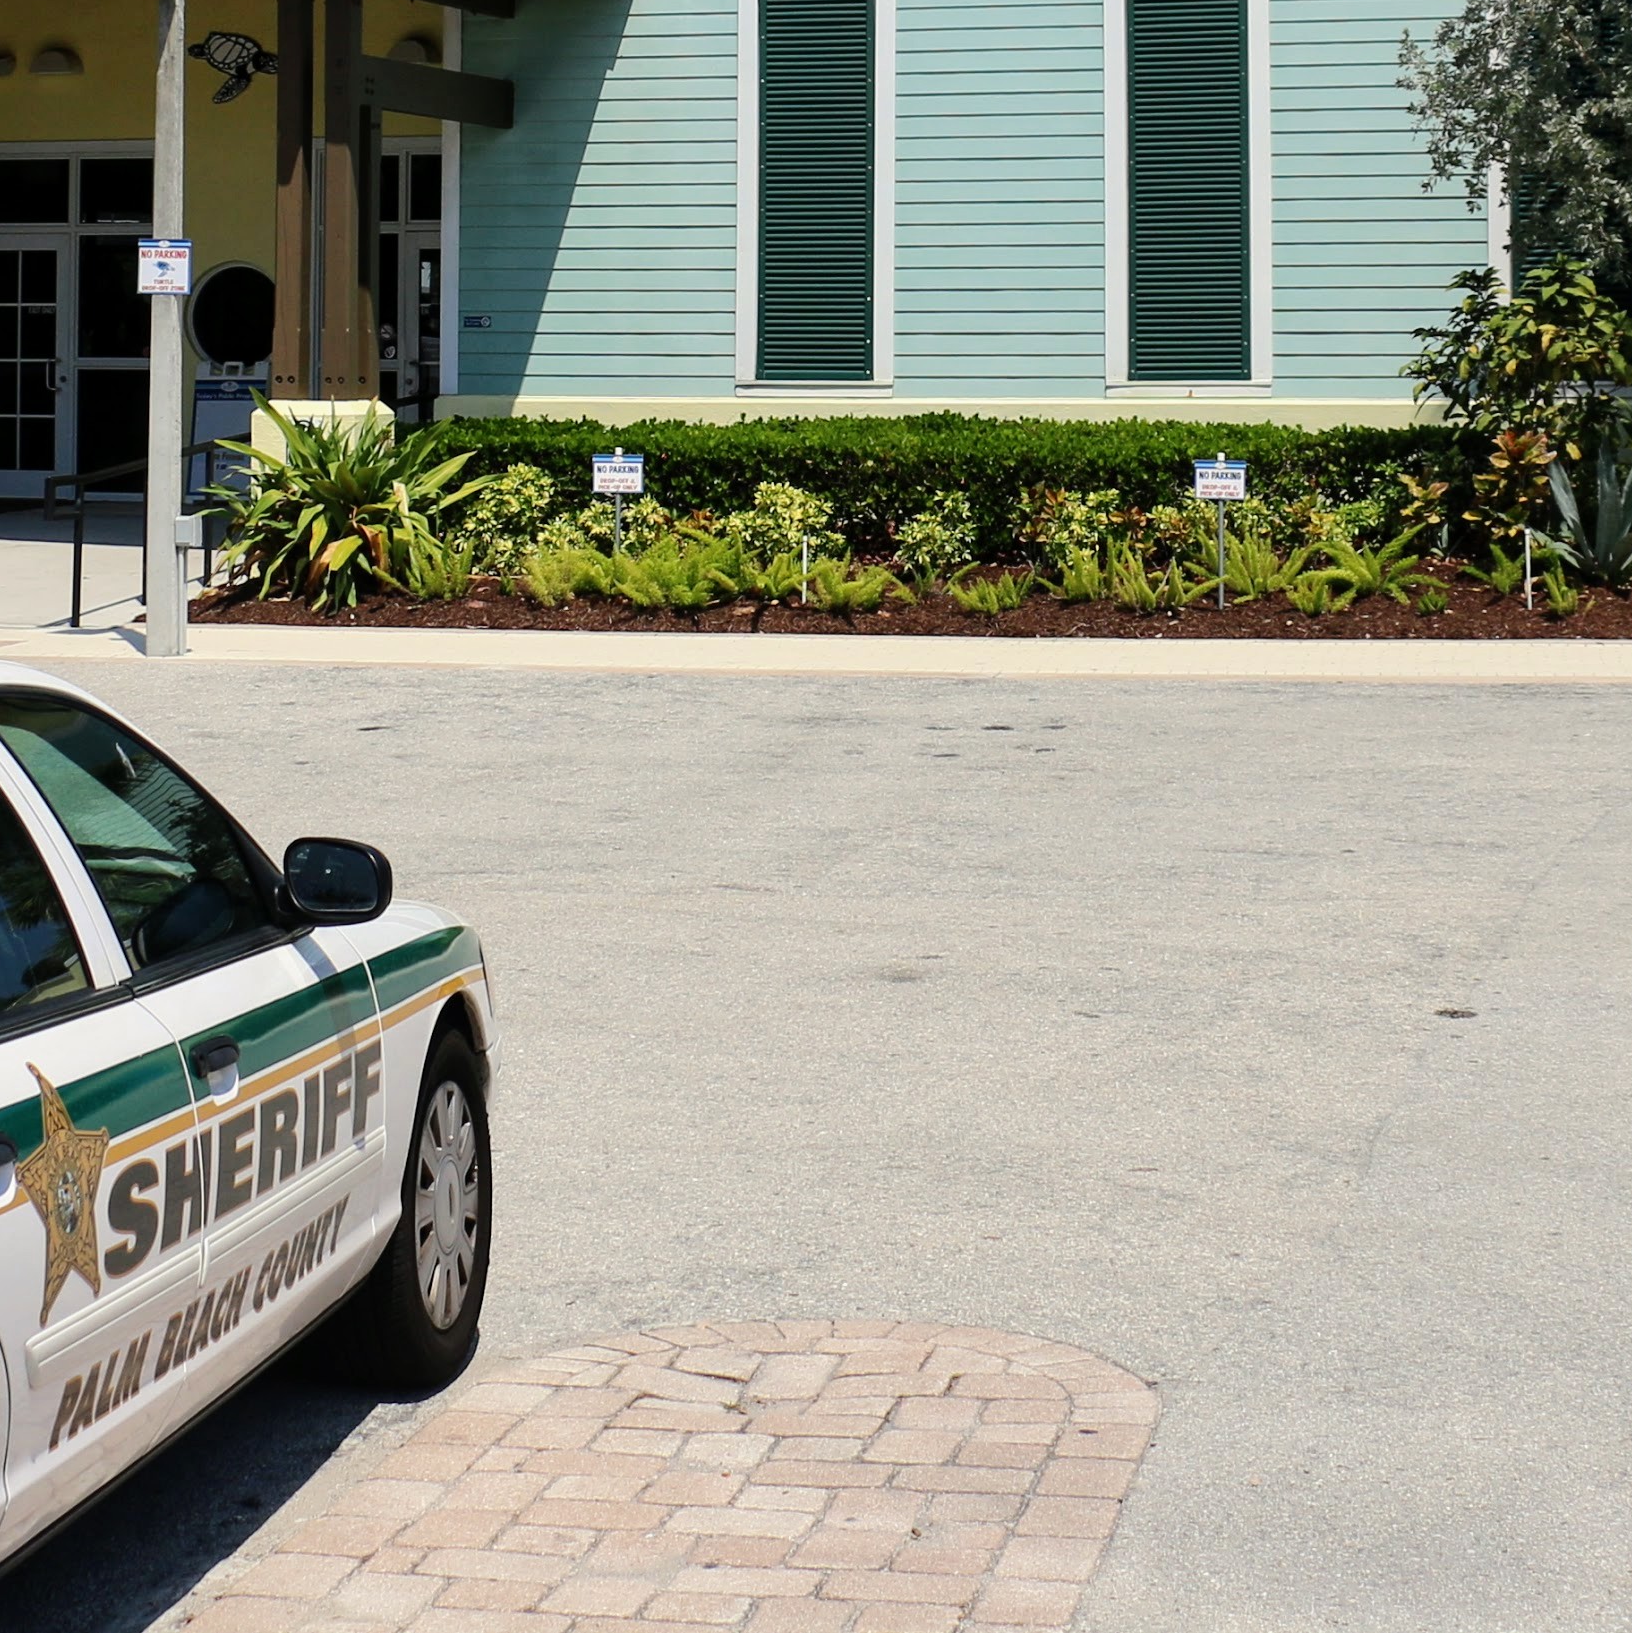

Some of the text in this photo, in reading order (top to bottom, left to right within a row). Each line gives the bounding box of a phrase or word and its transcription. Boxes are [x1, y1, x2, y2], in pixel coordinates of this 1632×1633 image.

[141, 250, 187, 259] NO PARKING
[1199, 472, 1241, 480] NO PARKING
[104, 1045, 382, 1279] SHERIFF
[48, 1192, 351, 1453] PALM BEACH COUNTY
